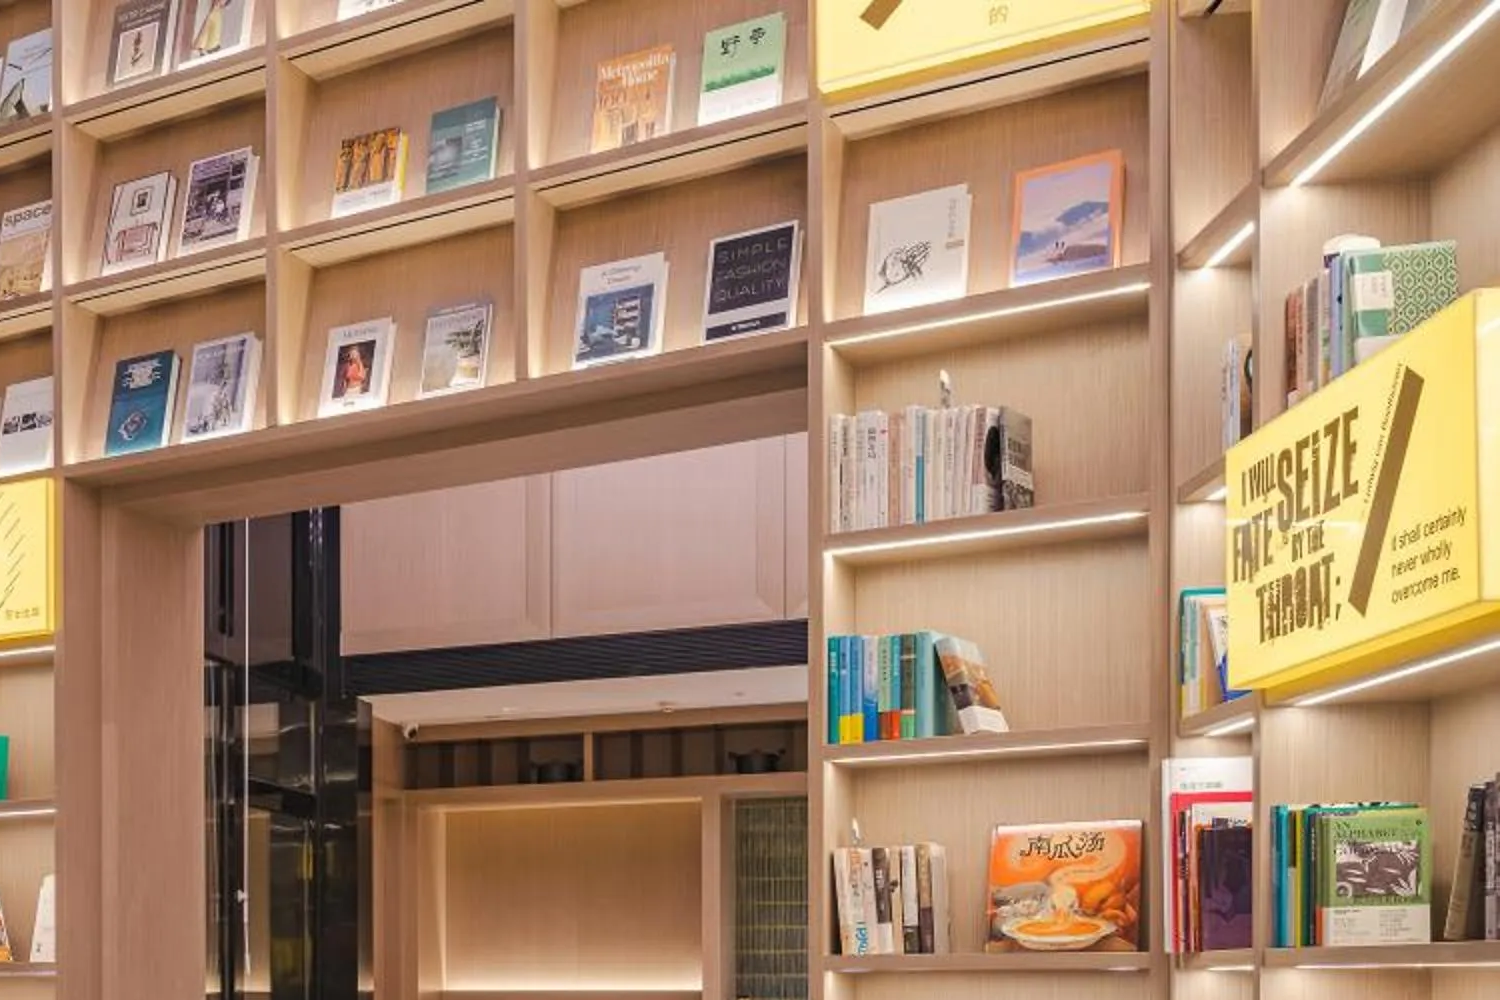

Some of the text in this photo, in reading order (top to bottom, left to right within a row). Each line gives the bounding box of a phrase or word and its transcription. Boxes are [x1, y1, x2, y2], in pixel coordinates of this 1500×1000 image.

[717, 237, 789, 264] SIMPLE
[1241, 452, 1277, 508] I WILL
[1277, 405, 1359, 533] SEIZE
[1232, 507, 1273, 584] FATE
[1291, 519, 1325, 563] BY THE
[1399, 523, 1421, 550] shall
[1423, 505, 1467, 537] certainly
[1391, 539, 1452, 578] never wholly
[1255, 552, 1342, 644] THROAT;
[1391, 575, 1440, 604] overcome
[1019, 831, 1106, 860] 南瓜汤
